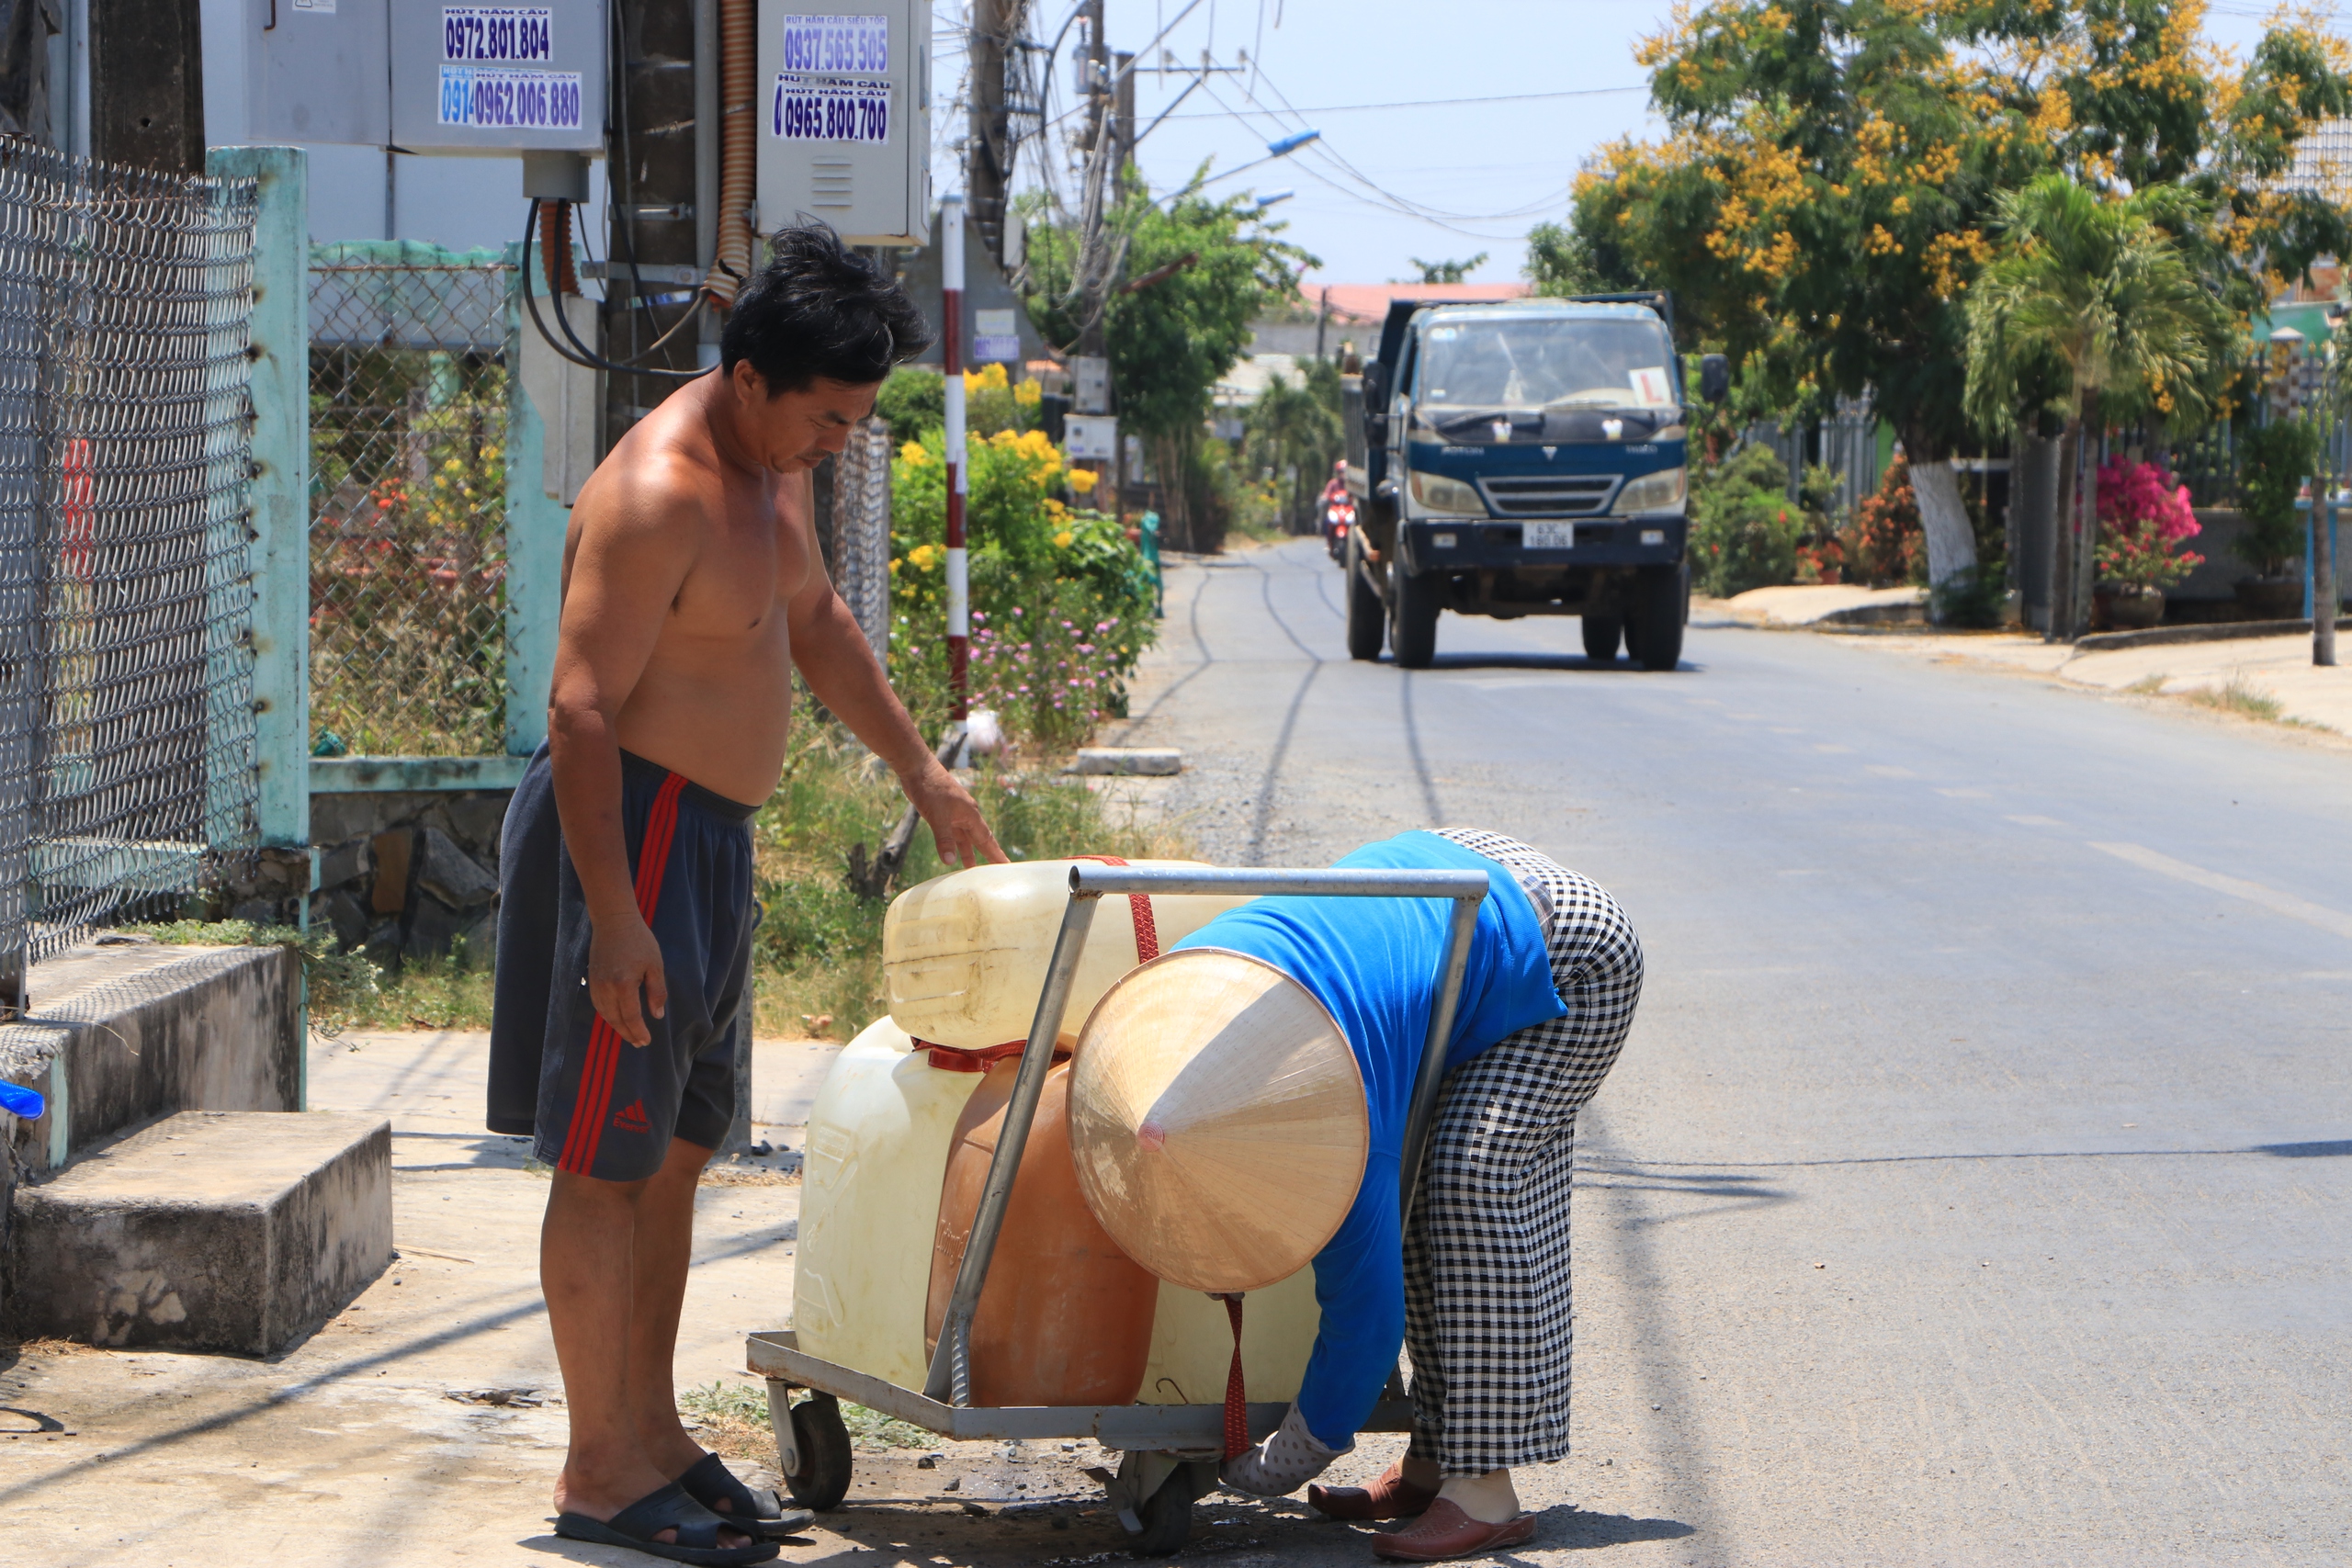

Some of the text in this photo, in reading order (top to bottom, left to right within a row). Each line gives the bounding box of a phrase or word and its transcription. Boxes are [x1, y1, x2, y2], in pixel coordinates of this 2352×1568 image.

[446, 17, 549, 60] 0972.801.804
[785, 28, 887, 71] 0937.565.505
[475, 80, 579, 126] 0962.006.880
[785, 96, 887, 141] 0965.800.700
